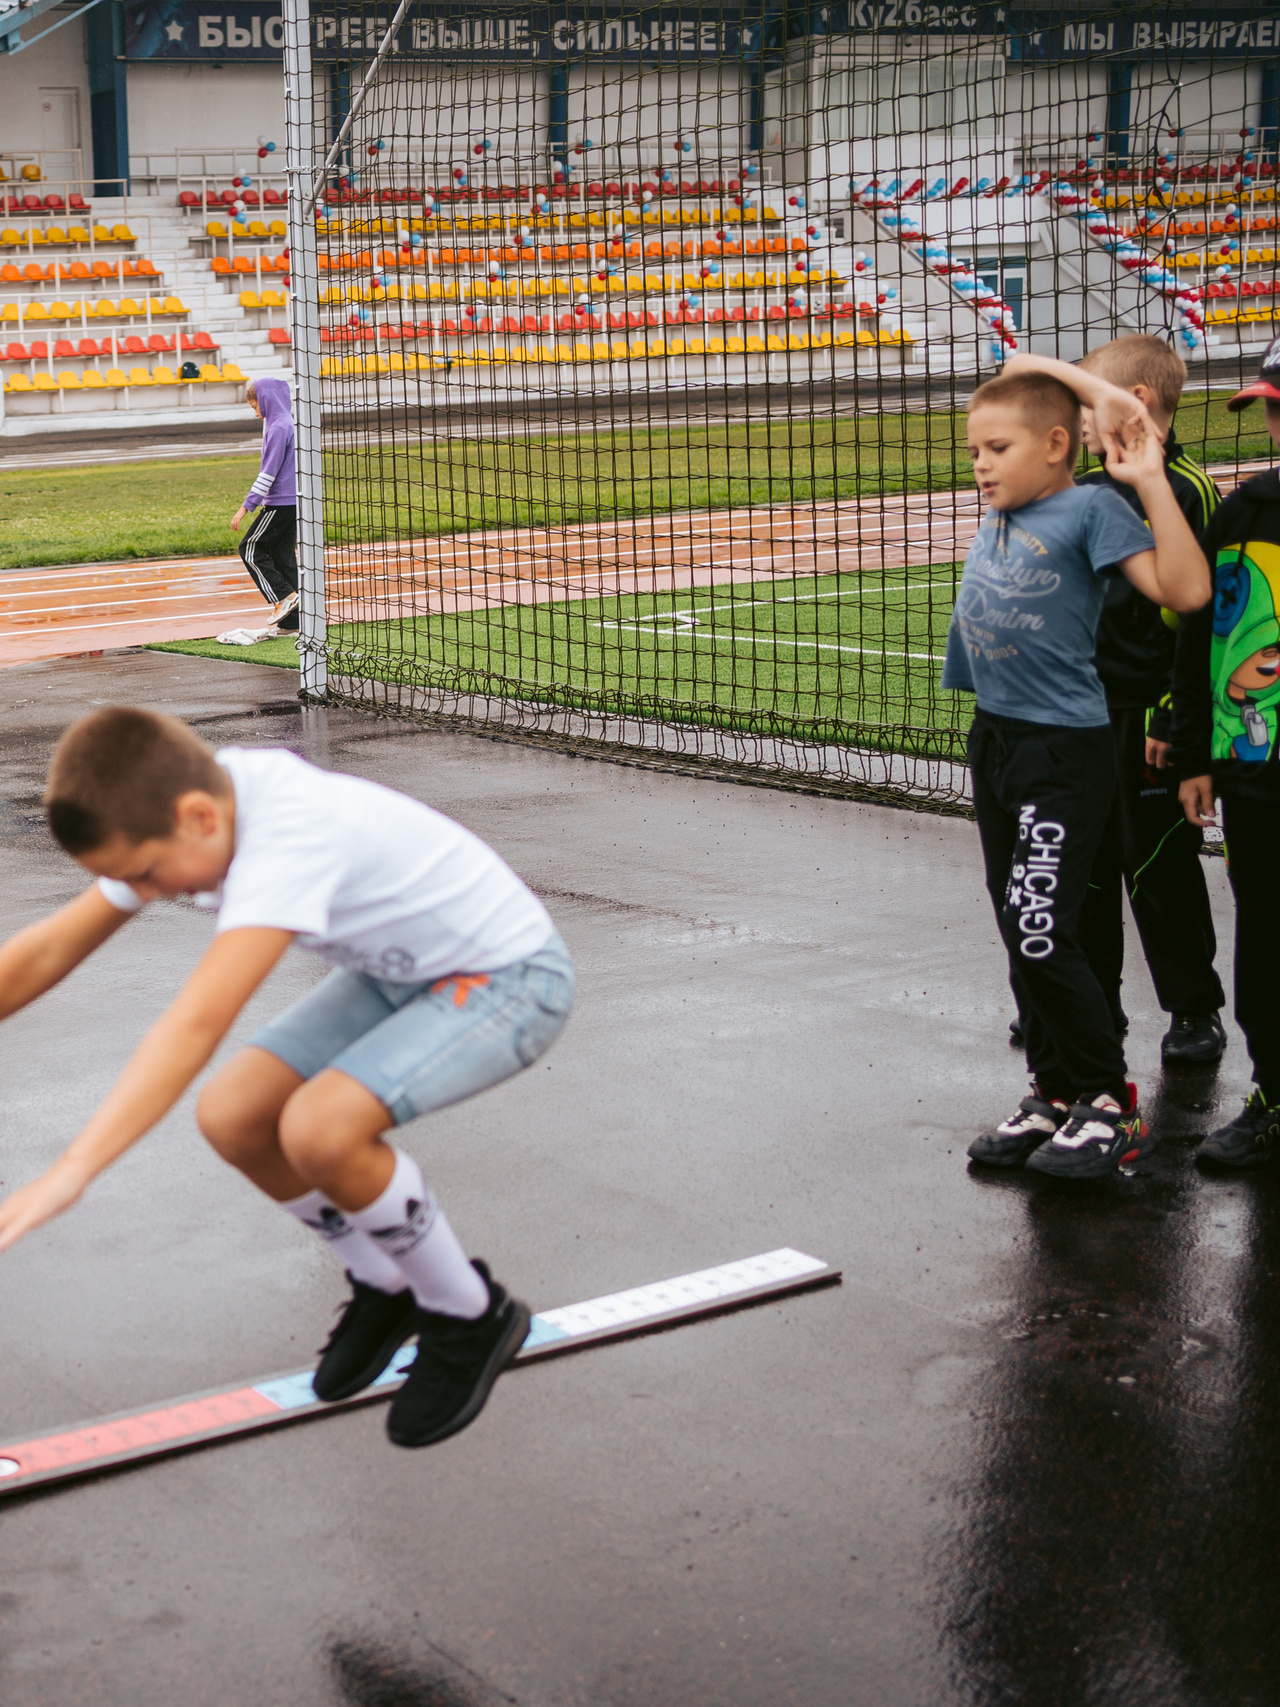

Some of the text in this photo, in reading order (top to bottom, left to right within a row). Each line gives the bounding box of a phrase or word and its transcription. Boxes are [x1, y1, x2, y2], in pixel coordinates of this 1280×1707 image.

[198, 15, 400, 53] БЫСРЕЕ,
[411, 17, 541, 58] ВЫШЕ,
[1063, 21, 1115, 50] МЫ
[957, 583, 1045, 631] Denim
